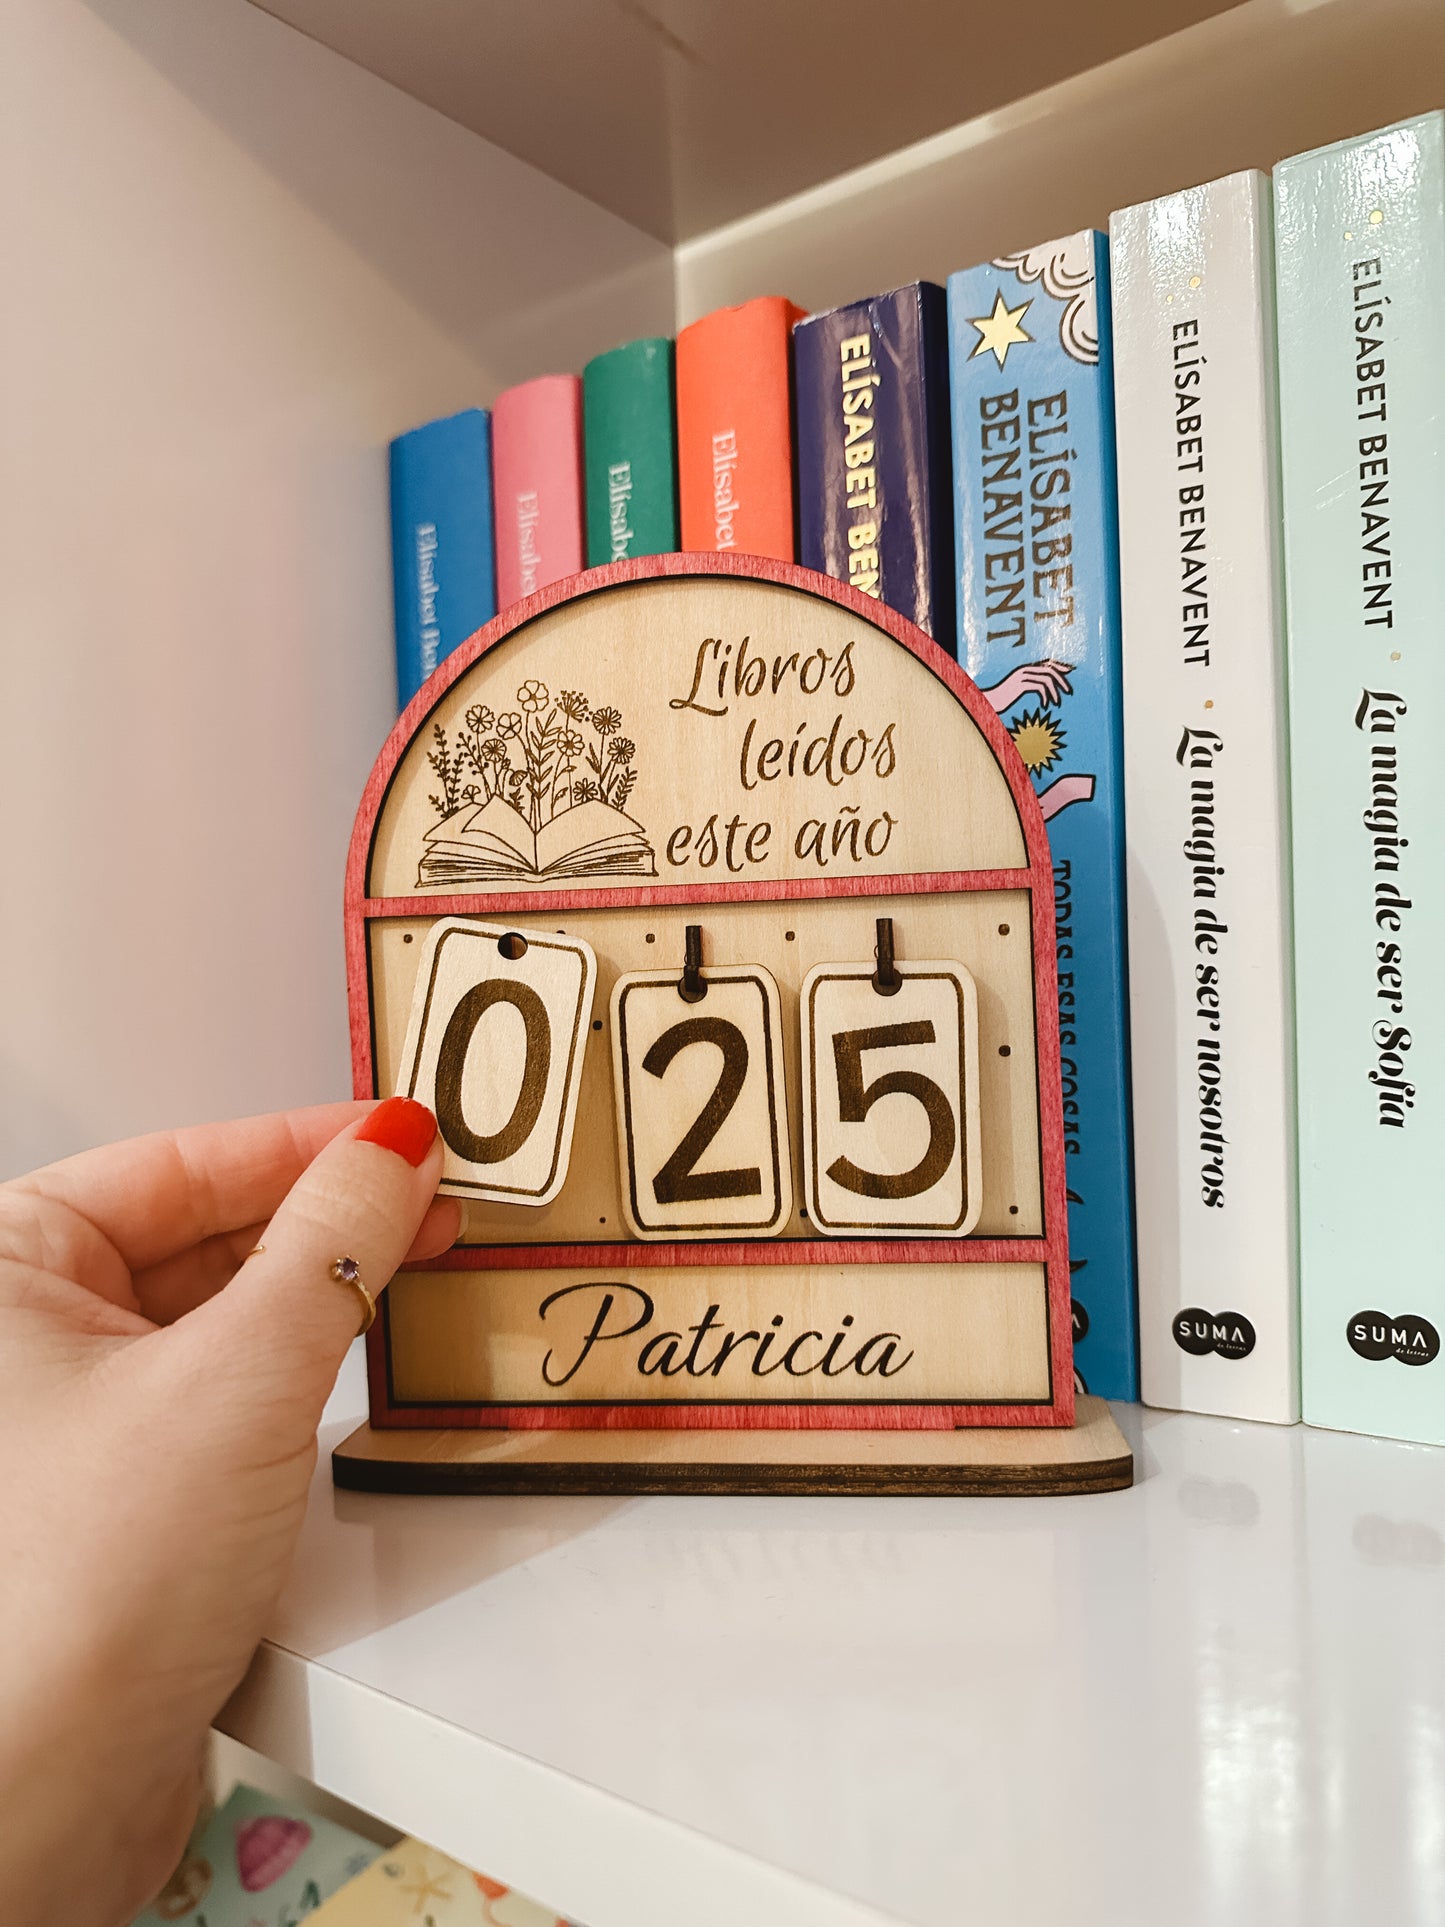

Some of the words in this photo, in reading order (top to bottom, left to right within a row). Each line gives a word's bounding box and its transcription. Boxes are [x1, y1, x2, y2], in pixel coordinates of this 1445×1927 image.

[1352, 256, 1387, 421] ELÍSABET
[840, 333, 881, 510] ELÍSABET
[1172, 318, 1204, 474] ELÍSABET
[979, 388, 1026, 648] BENAVENT
[1027, 389, 1078, 628] ELÍSABET
[1358, 434, 1393, 630] BENAVENT
[1179, 484, 1210, 668] BENAVENT
[668, 636, 856, 716] Libros
[1355, 687, 1408, 733] La
[740, 713, 896, 790] leídos
[1176, 725, 1224, 769] La
[666, 814, 772, 872] este
[794, 805, 899, 867] año
[1183, 779, 1225, 899] magia
[1363, 745, 1409, 872] magia
[1194, 908, 1229, 955] de
[1375, 882, 1412, 932] de
[1195, 963, 1221, 1032] ser
[1375, 941, 1404, 1014] ser
[641, 1016, 762, 1205] 2
[824, 1019, 956, 1200] 5
[1196, 1038, 1231, 1208] nosotros
[539, 1281, 914, 1387] Patricia
[1179, 1320, 1246, 1344] SUMA
[1354, 1324, 1427, 1348] SUMA
